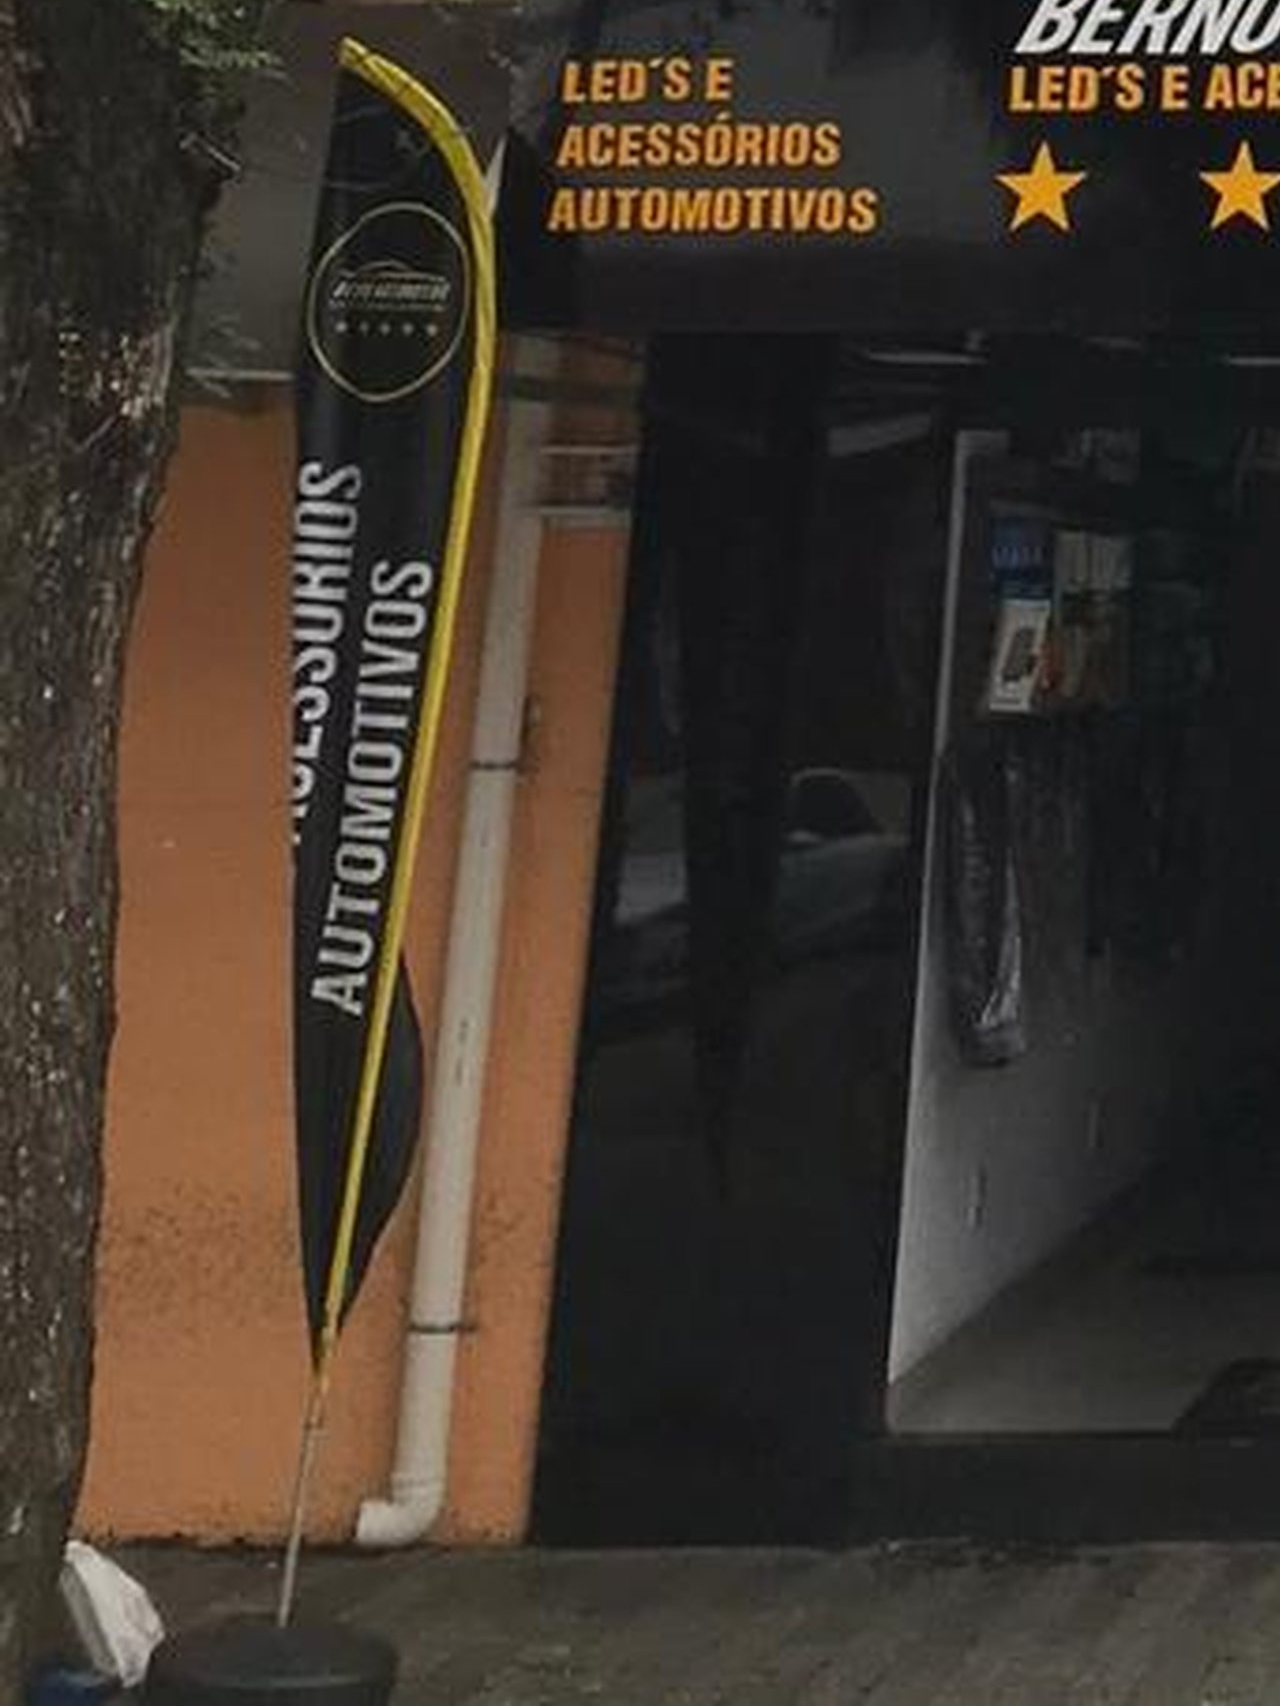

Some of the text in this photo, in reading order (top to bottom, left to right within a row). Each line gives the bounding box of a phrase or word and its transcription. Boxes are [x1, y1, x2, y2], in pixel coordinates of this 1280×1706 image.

[703, 58, 733, 101] E
[1160, 63, 1188, 110] E
[556, 112, 841, 167] ACESSÓRIOS
[547, 188, 878, 233] AUTOMOTIVOS
[310, 560, 434, 1016] AUTOMOTIVOS
